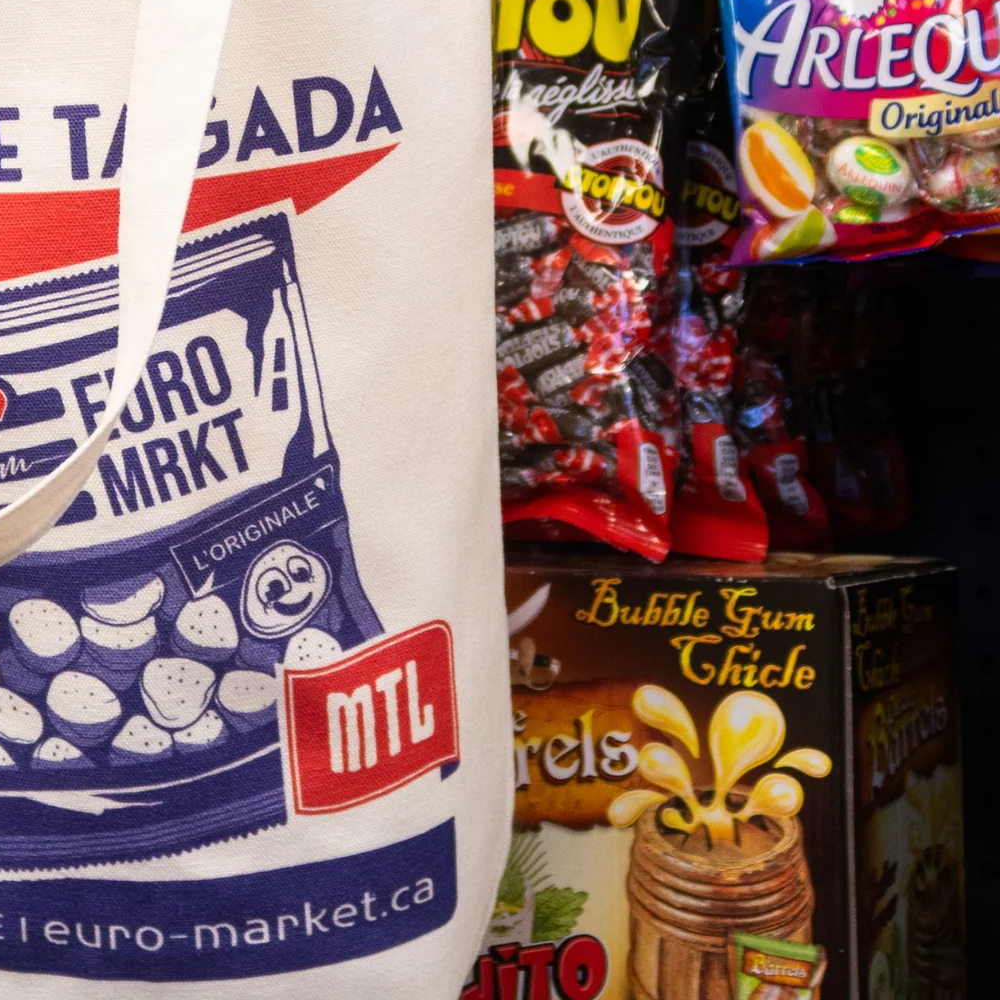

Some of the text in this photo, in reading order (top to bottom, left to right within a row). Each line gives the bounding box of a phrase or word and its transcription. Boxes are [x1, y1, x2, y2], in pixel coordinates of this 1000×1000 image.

[71, 335, 233, 444] EURO
[98, 409, 251, 517] MRKT
[192, 491, 320, 571] L'ORIGINALE
[576, 578, 815, 638] Bubble Gum
[670, 634, 816, 691] Chicle
[325, 659, 436, 774] MTL
[45, 875, 436, 953] euro-market.ca
